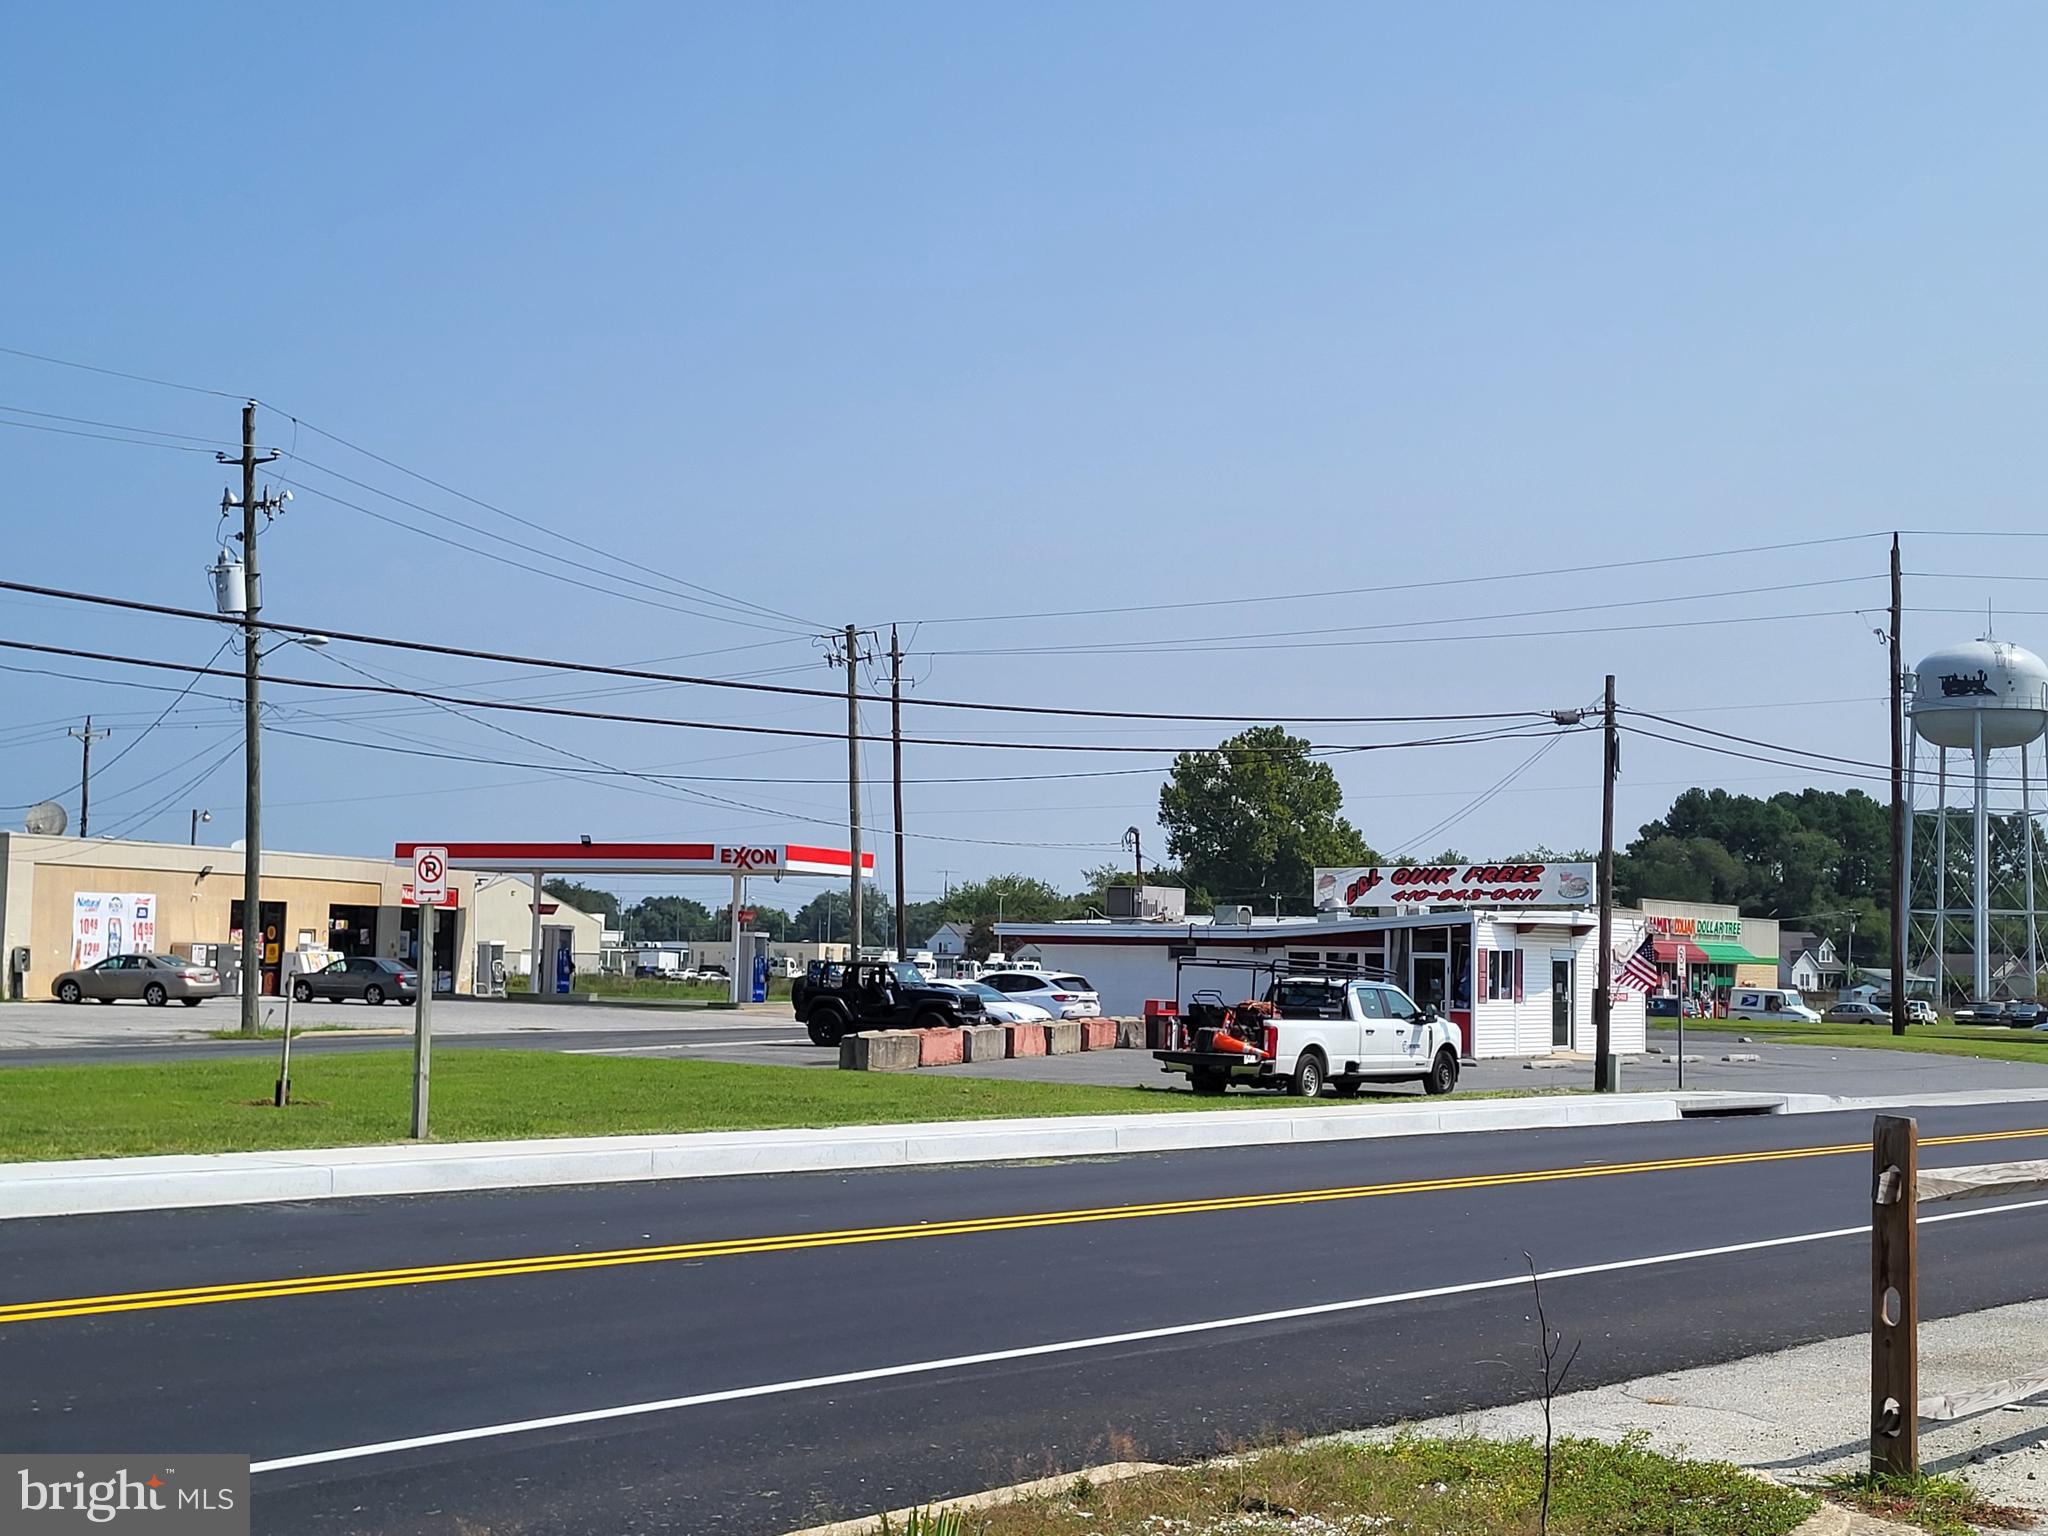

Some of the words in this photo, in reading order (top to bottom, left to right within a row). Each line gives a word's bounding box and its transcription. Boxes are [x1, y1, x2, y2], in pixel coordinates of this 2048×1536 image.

[720, 846, 777, 870] EXXON
[1390, 867, 1458, 885] QUIK
[1463, 864, 1545, 884] FREEZ
[1696, 920, 1724, 935] DOLLAR
[1724, 921, 1741, 935] TREE
